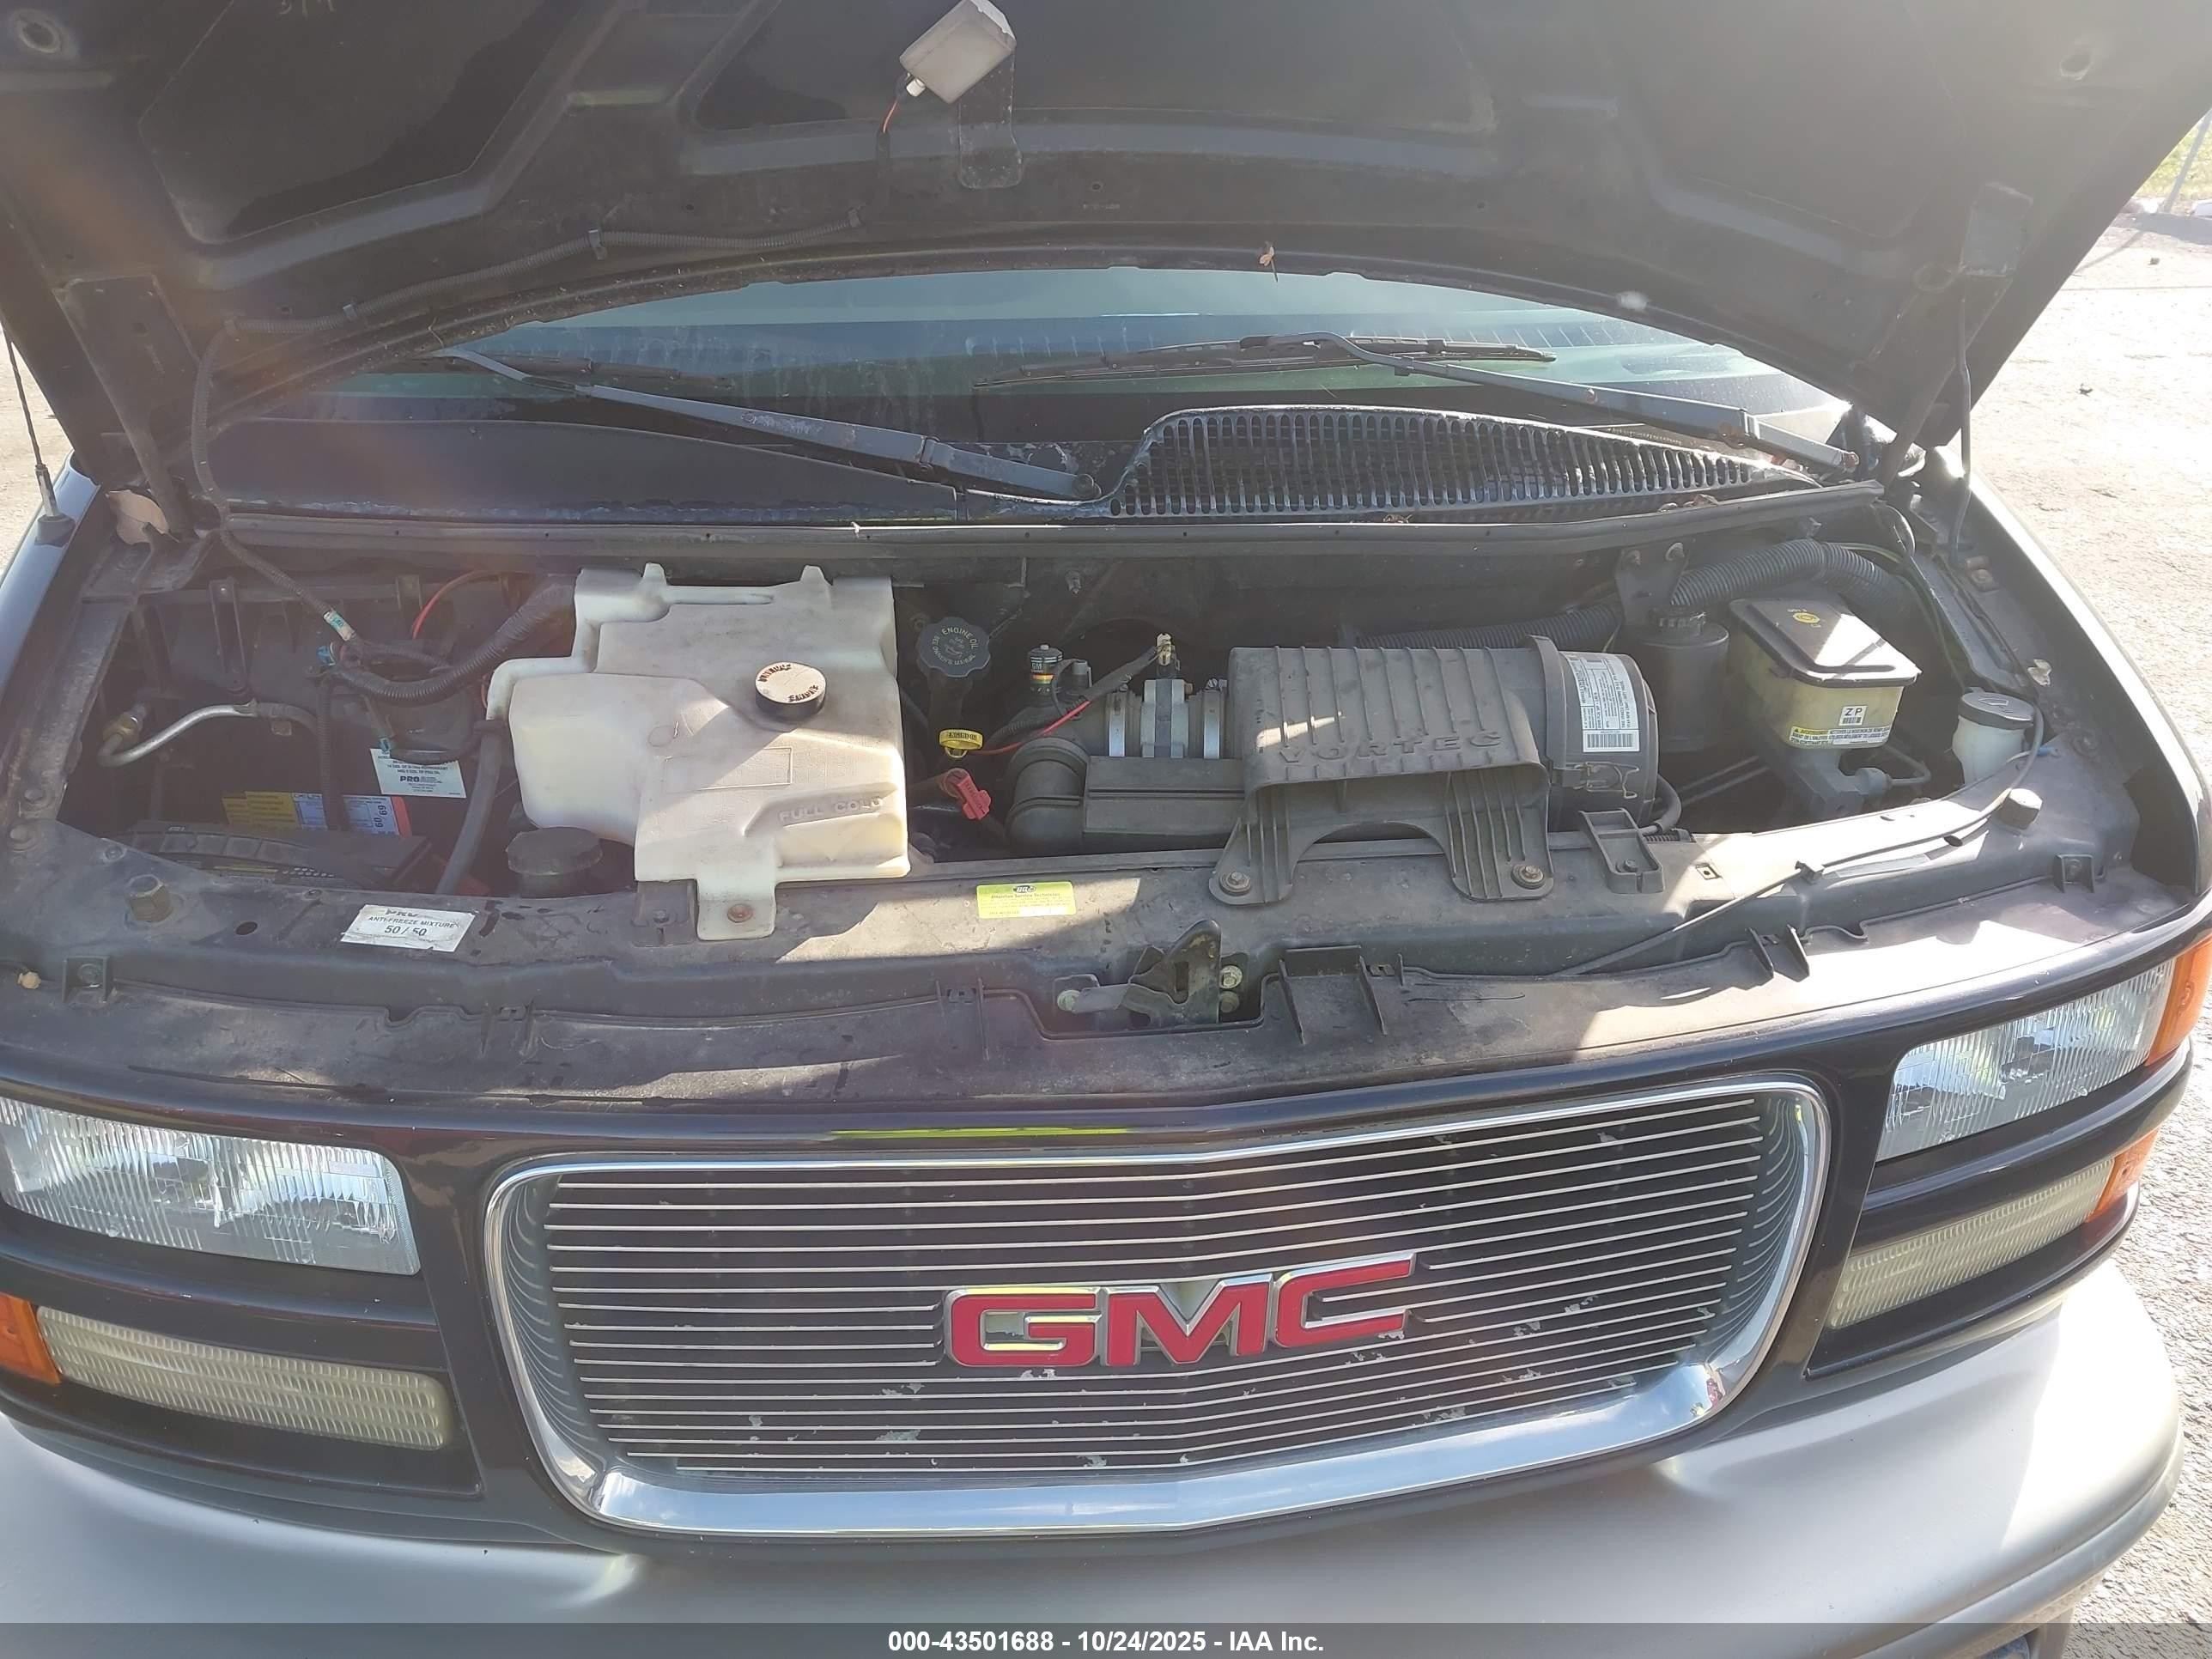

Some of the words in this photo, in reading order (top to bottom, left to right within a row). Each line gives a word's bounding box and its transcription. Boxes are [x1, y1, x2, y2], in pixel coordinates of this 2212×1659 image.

[941, 627, 974, 640] ENGINE
[969, 638, 979, 650] OIL
[1279, 730, 1502, 763] VORTEC
[780, 807, 824, 822] FULL
[835, 797, 883, 811] COLD
[368, 916, 418, 926] ANTI-FREEZE
[420, 920, 455, 929] MIXTURE
[944, 1252, 1417, 1368] GMC
